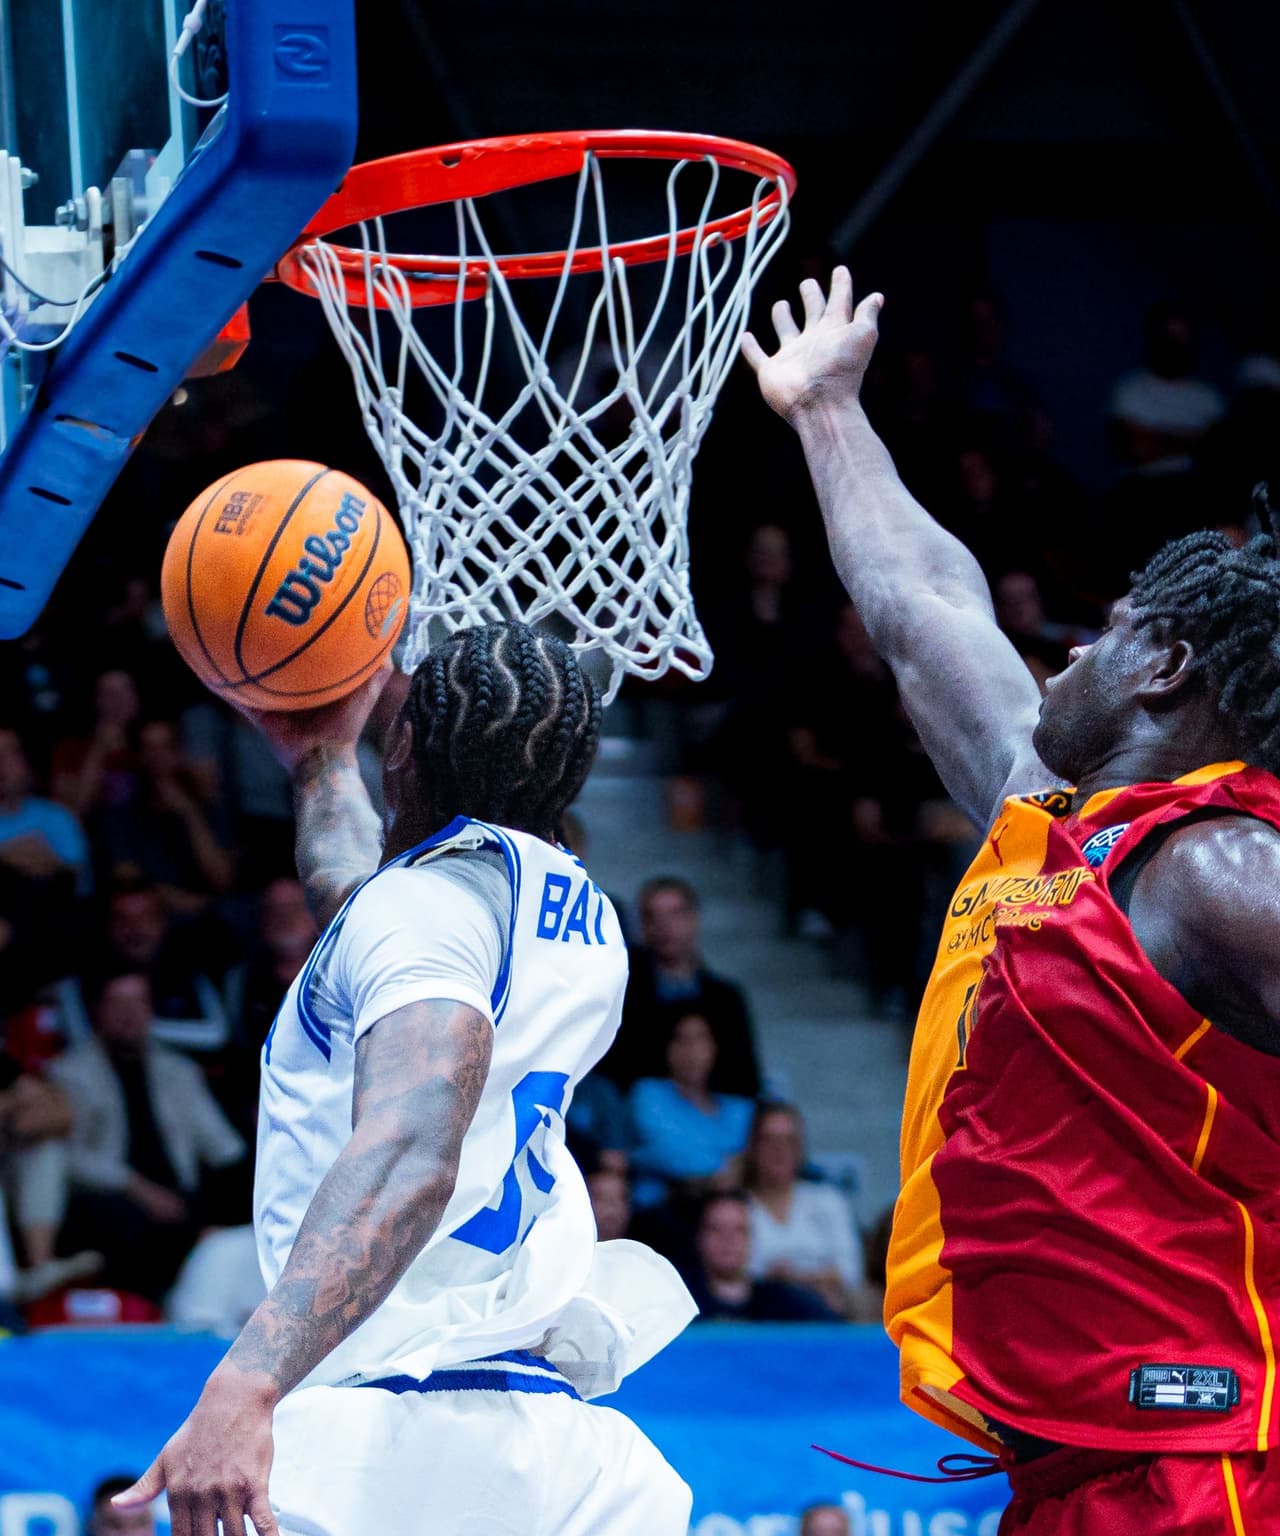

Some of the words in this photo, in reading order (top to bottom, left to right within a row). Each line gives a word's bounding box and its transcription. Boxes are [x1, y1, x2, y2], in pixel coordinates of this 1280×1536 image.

[214, 491, 252, 534] FIBA
[263, 491, 367, 627] Wilson
[1192, 1370, 1224, 1387] 2XL
